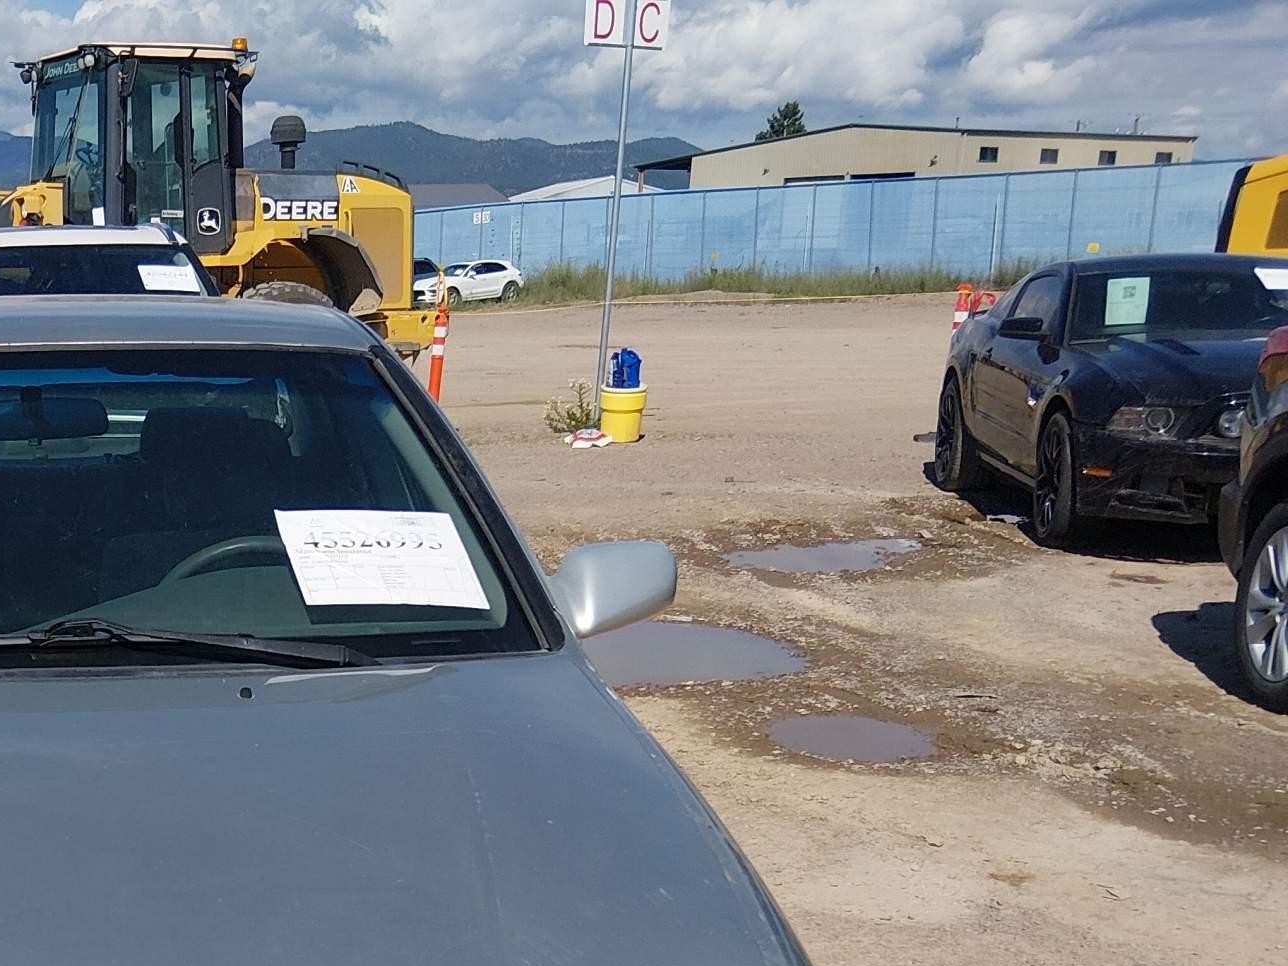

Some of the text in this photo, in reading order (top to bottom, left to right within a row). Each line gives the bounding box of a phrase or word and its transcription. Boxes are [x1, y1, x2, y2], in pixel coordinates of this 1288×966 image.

[594, 0, 661, 43] D C
[44, 65, 64, 79] JOHN
[260, 197, 338, 220] DEERE
